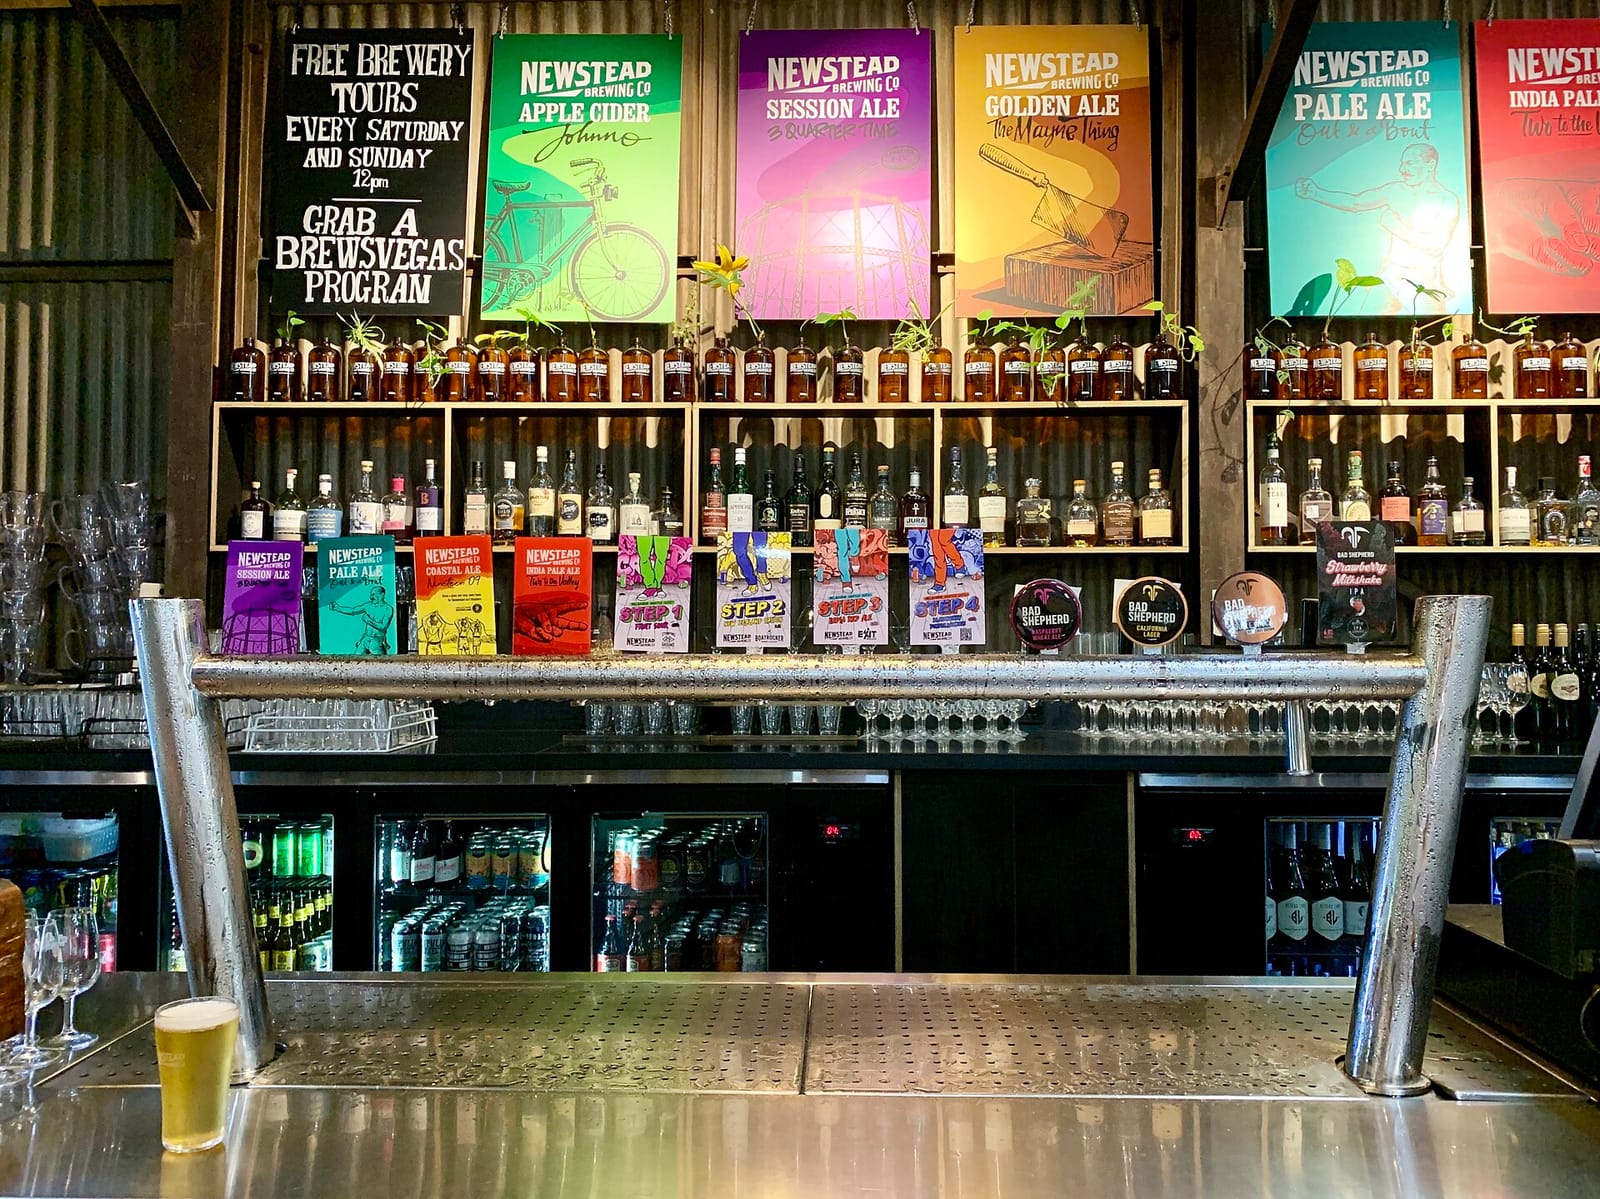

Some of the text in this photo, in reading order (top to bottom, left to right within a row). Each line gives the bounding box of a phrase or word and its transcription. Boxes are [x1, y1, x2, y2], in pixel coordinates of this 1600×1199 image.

[291, 43, 471, 77] FREE BREWERY
[1294, 50, 1429, 87] NEWSTEAD
[521, 61, 652, 96] NEWSTEAD
[767, 56, 900, 93] NEWSTEAD
[985, 52, 1119, 88] NEWSTEAD
[1576, 72, 1600, 84] BRE
[832, 77, 884, 94] BREWING
[1051, 73, 1102, 90] BREWING
[1361, 72, 1412, 88] BREWING
[331, 82, 419, 114] TOURS
[584, 84, 634, 98] BREWING
[1509, 90, 1560, 108] INDIA
[519, 103, 651, 123] APPLE CIDER
[767, 98, 900, 119] SESSION ALE
[985, 94, 1120, 117] GOLDEN ALE
[1294, 93, 1432, 121] PALE ALE
[286, 116, 464, 142] EVERY SATURDAY
[768, 120, 900, 142] 3 QUARTER TIME
[986, 116, 1013, 139] The
[1013, 117, 1077, 147] Mayne
[1511, 110, 1552, 137] Two
[1569, 114, 1593, 132] the
[303, 146, 432, 169] AND SUNDAY
[352, 169, 389, 193] 12pm
[302, 206, 418, 236] GRAB A
[275, 236, 464, 271] BREWSVEGAS
[305, 270, 431, 304] PROGRAM
[238, 552, 291, 567] NEWSTEAD
[329, 548, 382, 564] NEWSTEAD
[425, 547, 480, 564] NEWSTEAD
[526, 549, 580, 564] NEWSTEAD
[237, 569, 290, 579] SESSION ALE
[329, 565, 383, 578] PALE ALE
[426, 565, 481, 576] COASTAL ALE
[526, 566, 581, 575] INDIA PALE ALE
[1325, 560, 1387, 575] Strawberry
[1332, 574, 1383, 587] Milkshake
[619, 604, 684, 623] STEP 1
[721, 600, 786, 619] STEP 2
[818, 596, 883, 617] STEP 3
[914, 598, 964, 618] STEP
[965, 595, 980, 612] 4
[1022, 606, 1041, 616] BAD
[1128, 601, 1148, 612] BAD
[1224, 598, 1245, 611] BAD
[1022, 613, 1070, 626] SHEPHERD
[1128, 611, 1176, 624] SHEPHERD
